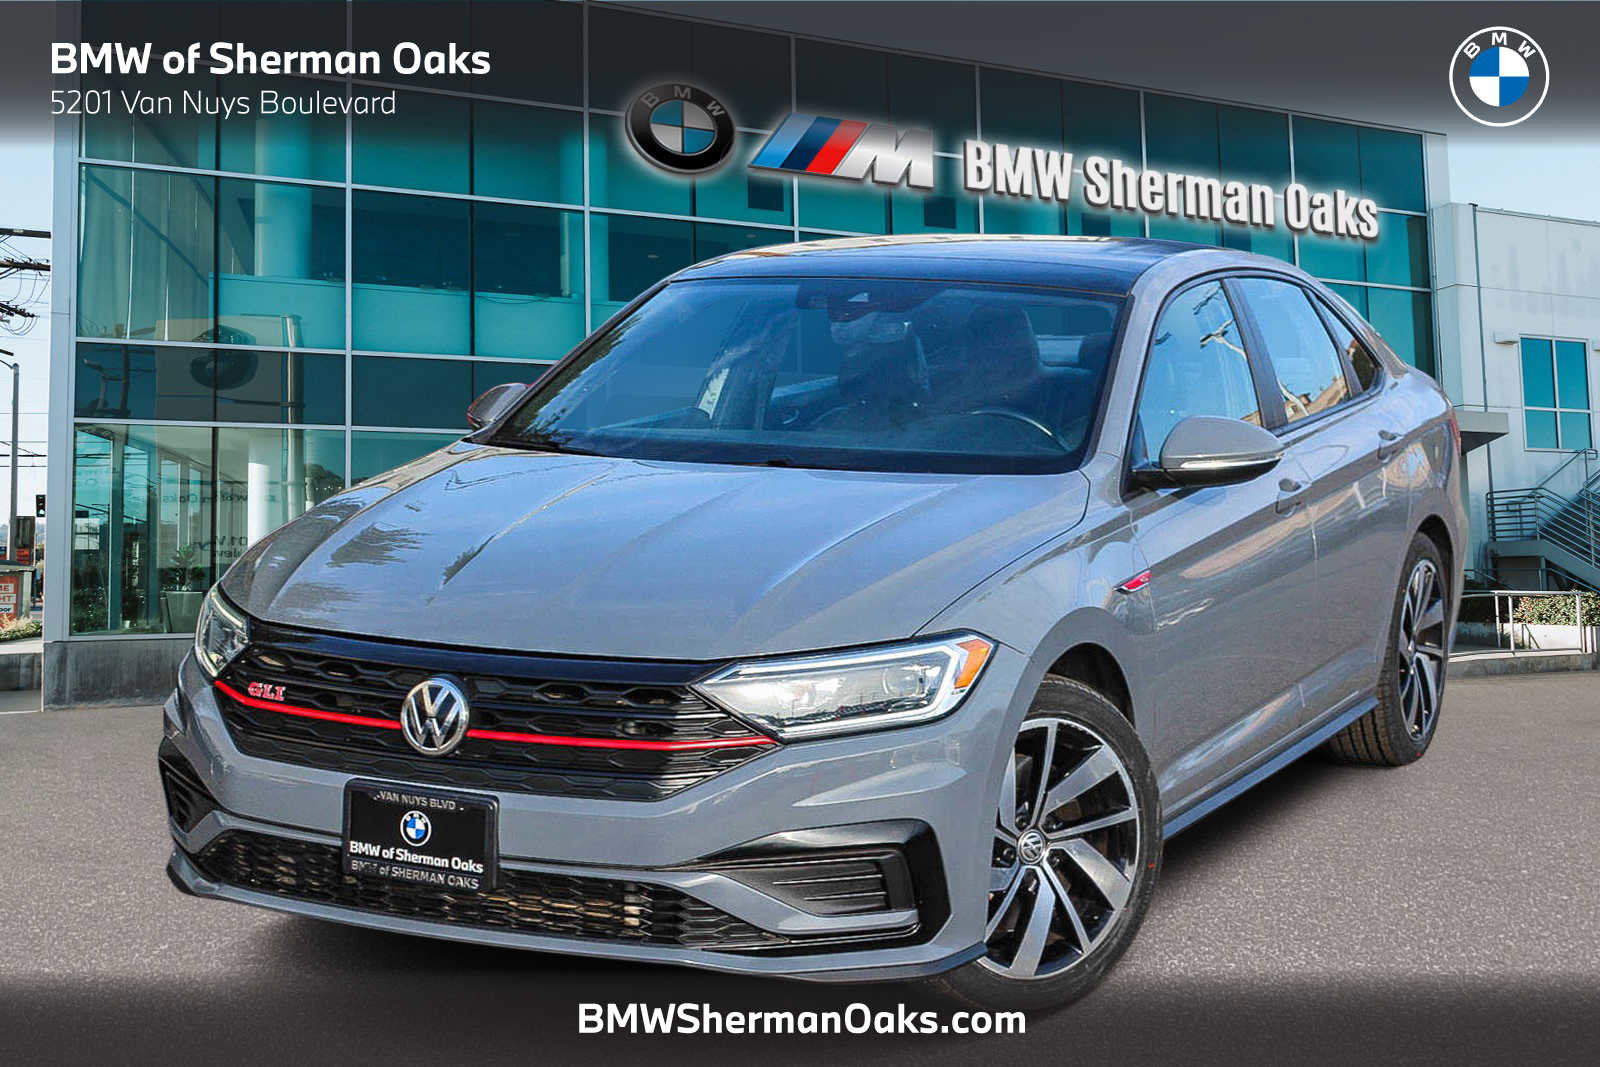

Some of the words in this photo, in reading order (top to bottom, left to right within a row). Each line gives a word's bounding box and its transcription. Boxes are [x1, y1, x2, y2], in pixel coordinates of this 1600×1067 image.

[641, 84, 726, 117] BMW
[963, 138, 1073, 202] BMW
[1082, 155, 1276, 228] Sherman
[1283, 182, 1379, 241] Oaks
[248, 681, 286, 701] GLI
[401, 794, 428, 807] NUYS
[429, 798, 456, 810] BLVD
[349, 840, 381, 857] BMW
[382, 846, 396, 860] of
[395, 848, 449, 869] Sherman
[450, 856, 484, 874] Oaks
[391, 866, 446, 885] SHERMAN
[447, 874, 480, 890] OAKS
